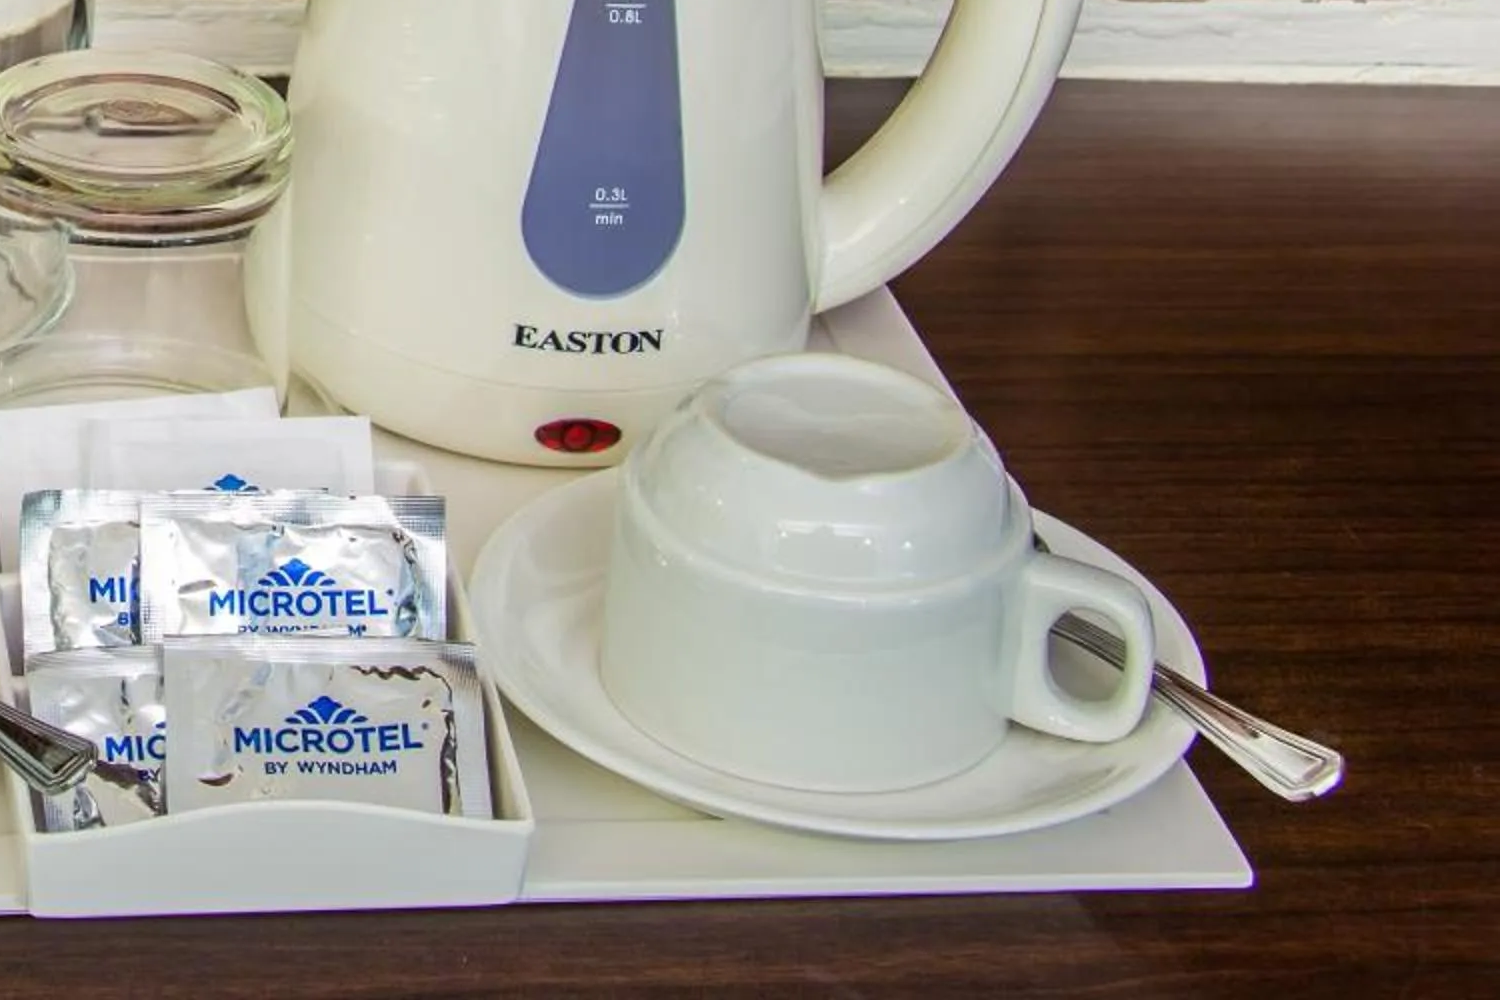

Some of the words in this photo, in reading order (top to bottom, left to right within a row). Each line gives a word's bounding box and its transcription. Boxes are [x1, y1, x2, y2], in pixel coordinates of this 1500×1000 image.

[610, 9, 643, 23] 0.8L
[595, 187, 628, 201] 0.3L
[596, 212, 623, 225] min
[513, 323, 664, 354] EASTON
[209, 589, 388, 617] MICROTEL
[233, 723, 424, 754] MICROTEL
[264, 760, 288, 775] BY
[297, 760, 398, 775] WYNDHAM
